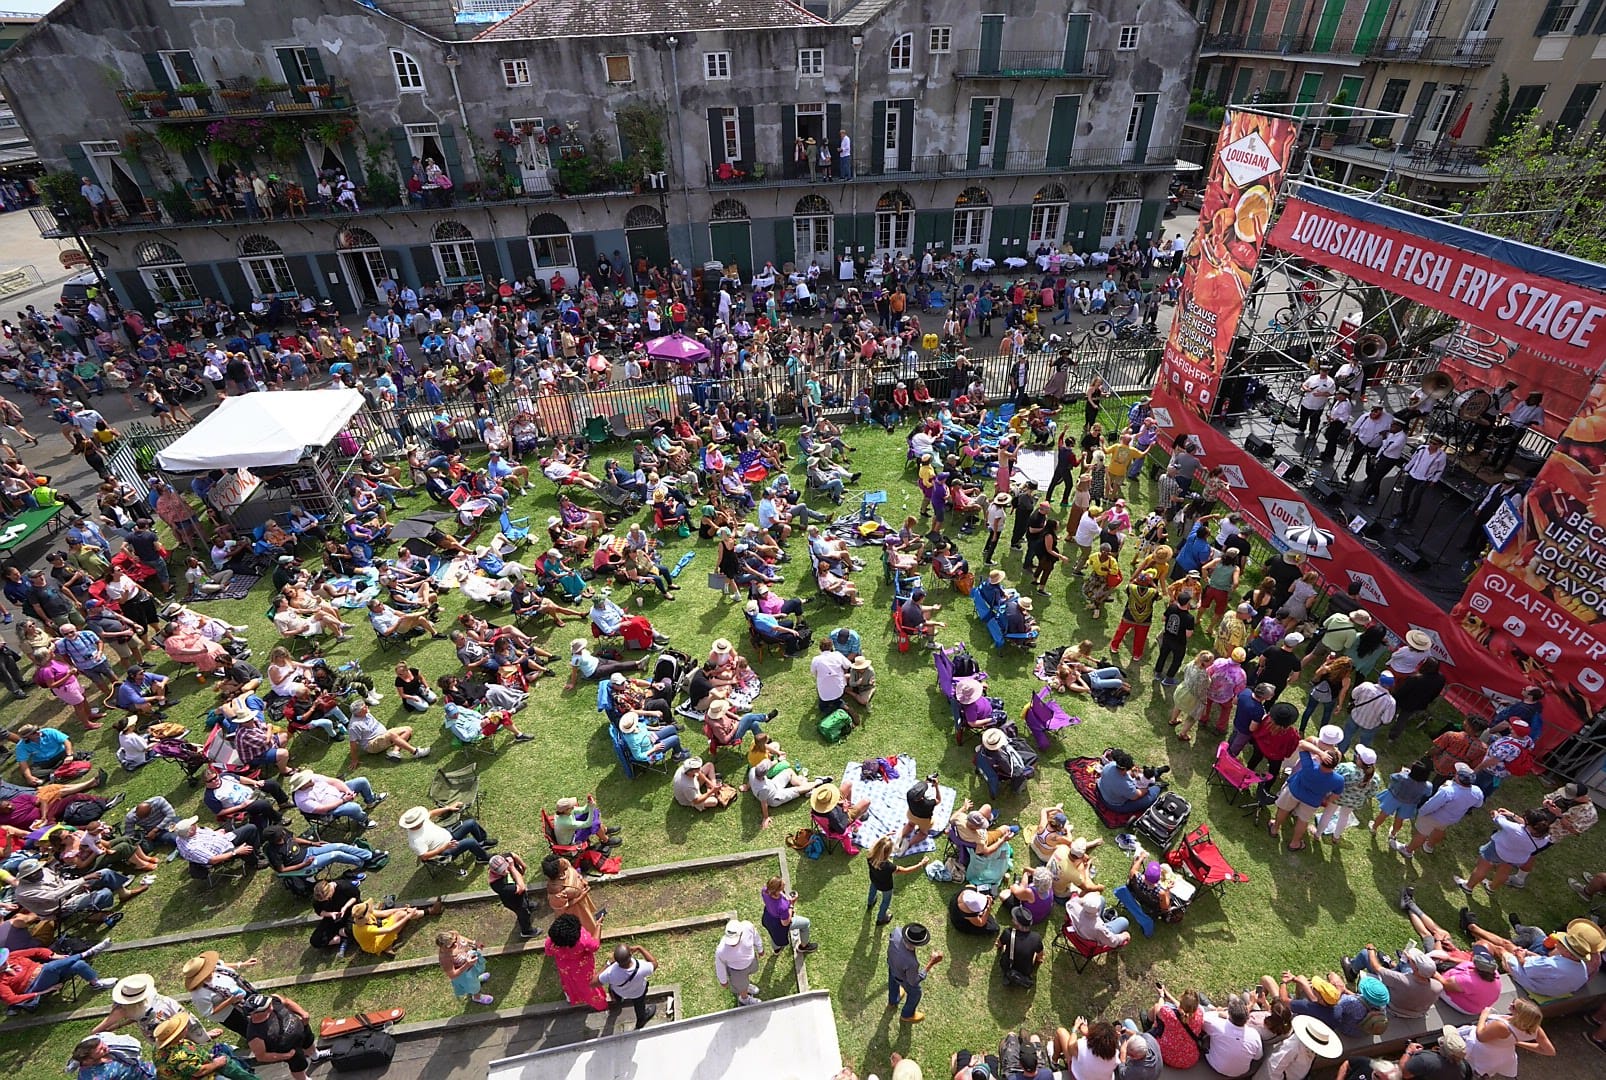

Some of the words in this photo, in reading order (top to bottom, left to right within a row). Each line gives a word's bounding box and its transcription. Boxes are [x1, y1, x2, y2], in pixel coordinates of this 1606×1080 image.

[1225, 148, 1270, 172] LOUISIANA
[1291, 210, 1394, 272] LOUISIANA
[1392, 244, 1453, 292] FISH
[1449, 263, 1507, 312] FRY
[1497, 282, 1606, 348] STAGE
[1192, 318, 1217, 338] NEEDS
[1179, 335, 1204, 359] FLAVOR
[1166, 348, 1213, 386] @LAFISHFRY
[1545, 522, 1583, 553] LIFE
[1536, 564, 1606, 617] FLAVOR
[1484, 574, 1606, 661] @LAFISHFR
